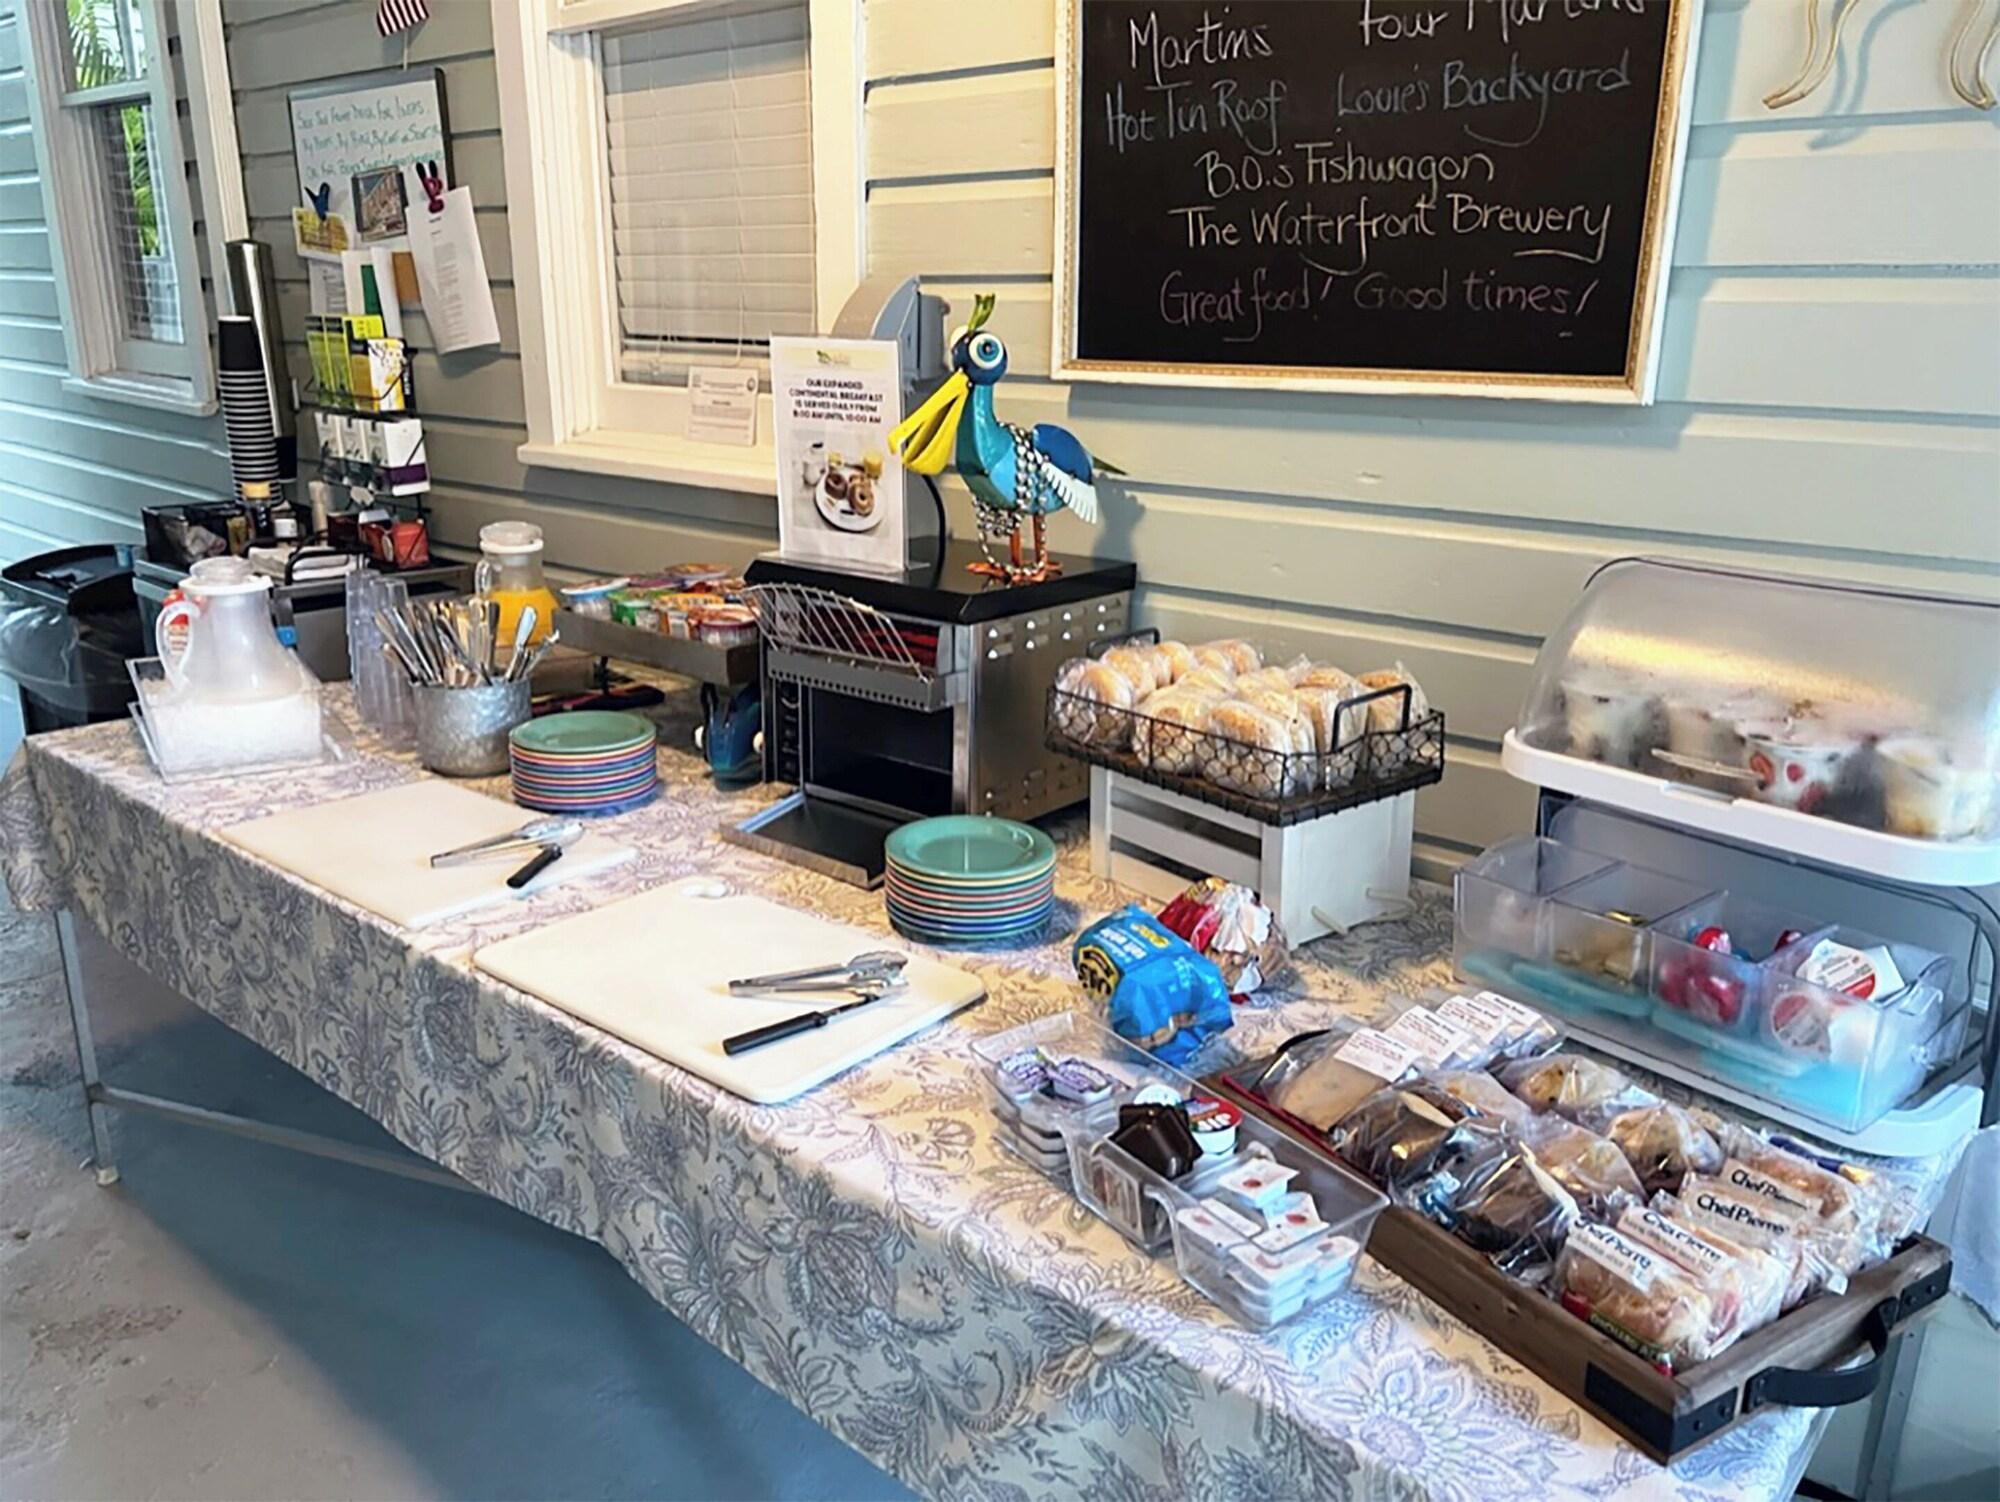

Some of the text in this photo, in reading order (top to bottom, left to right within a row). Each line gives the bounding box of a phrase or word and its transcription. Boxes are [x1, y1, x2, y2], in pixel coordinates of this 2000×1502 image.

[1105, 80, 1288, 155] Hot Tin Roof
[1443, 47, 1632, 147] Backyard
[1295, 128, 1495, 205] Fishwagon
[1168, 193, 1611, 276] The Waterfront Brewery
[1160, 269, 1246, 328] Great
[1354, 268, 1448, 309] Good
[789, 388, 883, 402] CONTINENTAL BREAKFAST
[804, 400, 831, 409] SERVED
[832, 401, 854, 411] DAILY
[855, 403, 878, 412] FROM
[823, 379, 864, 390] EXPANDED
[869, 415, 882, 424] AM
